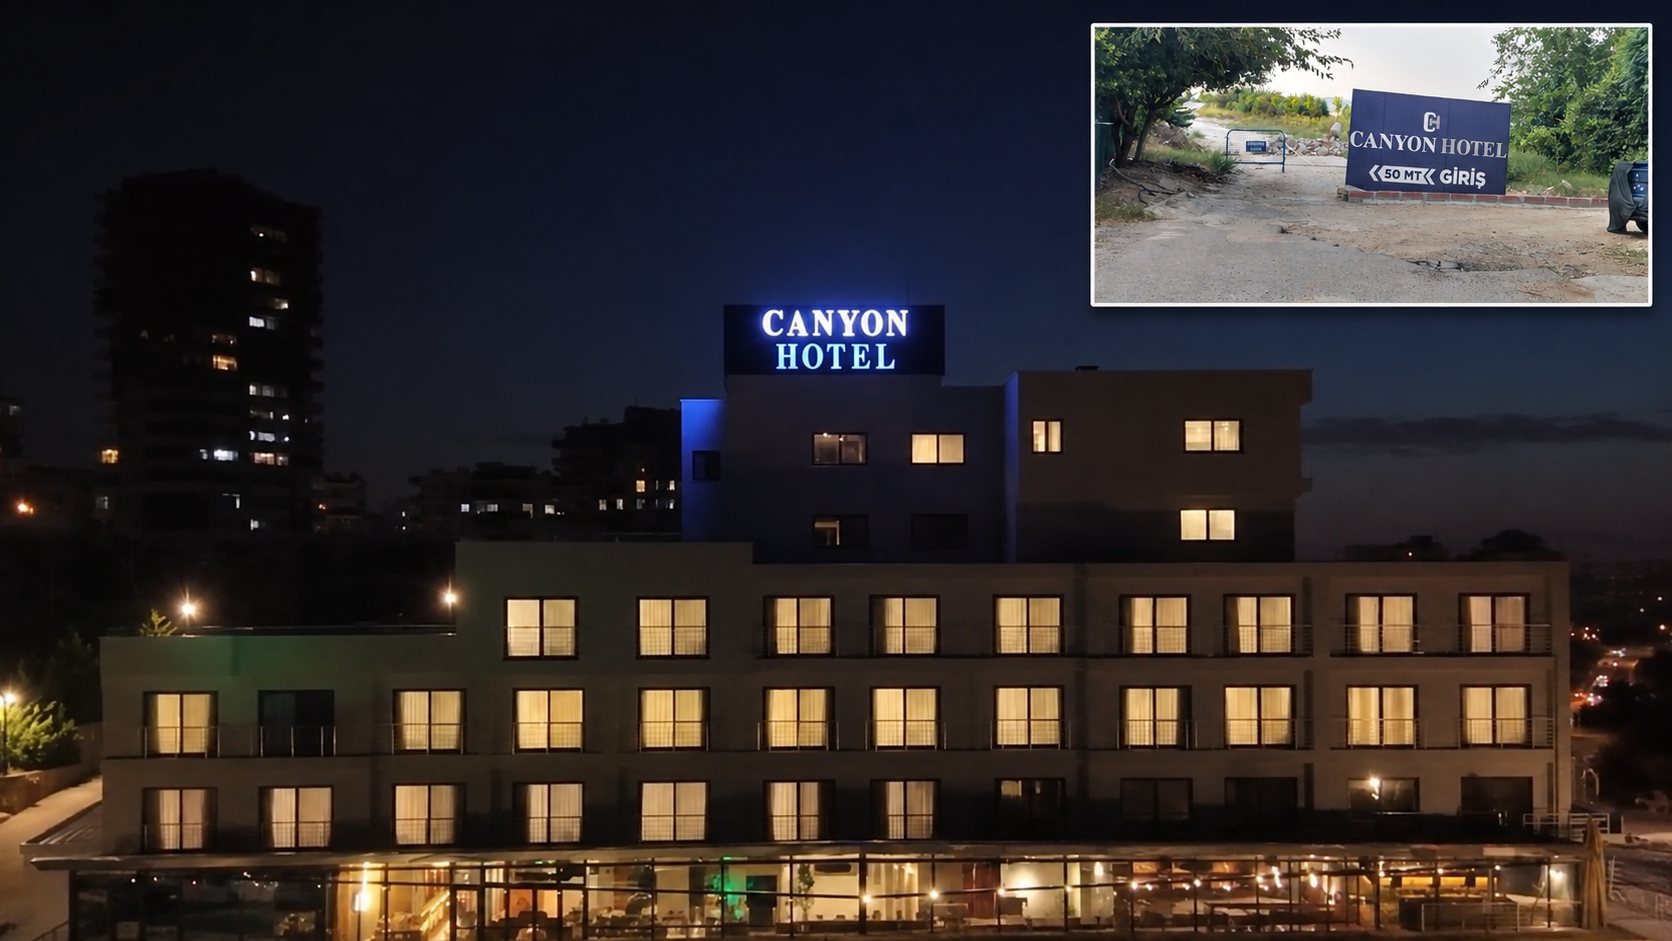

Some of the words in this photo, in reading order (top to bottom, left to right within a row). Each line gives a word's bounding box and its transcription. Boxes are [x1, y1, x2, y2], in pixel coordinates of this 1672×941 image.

[1350, 130, 1437, 153] CANYON
[1441, 138, 1507, 158] HOTEL
[1384, 169, 1400, 179] 50
[1404, 170, 1422, 181] MT
[1439, 166, 1486, 189] GİRİŞ
[762, 309, 909, 337] CANYON
[775, 343, 895, 370] HOTEL
